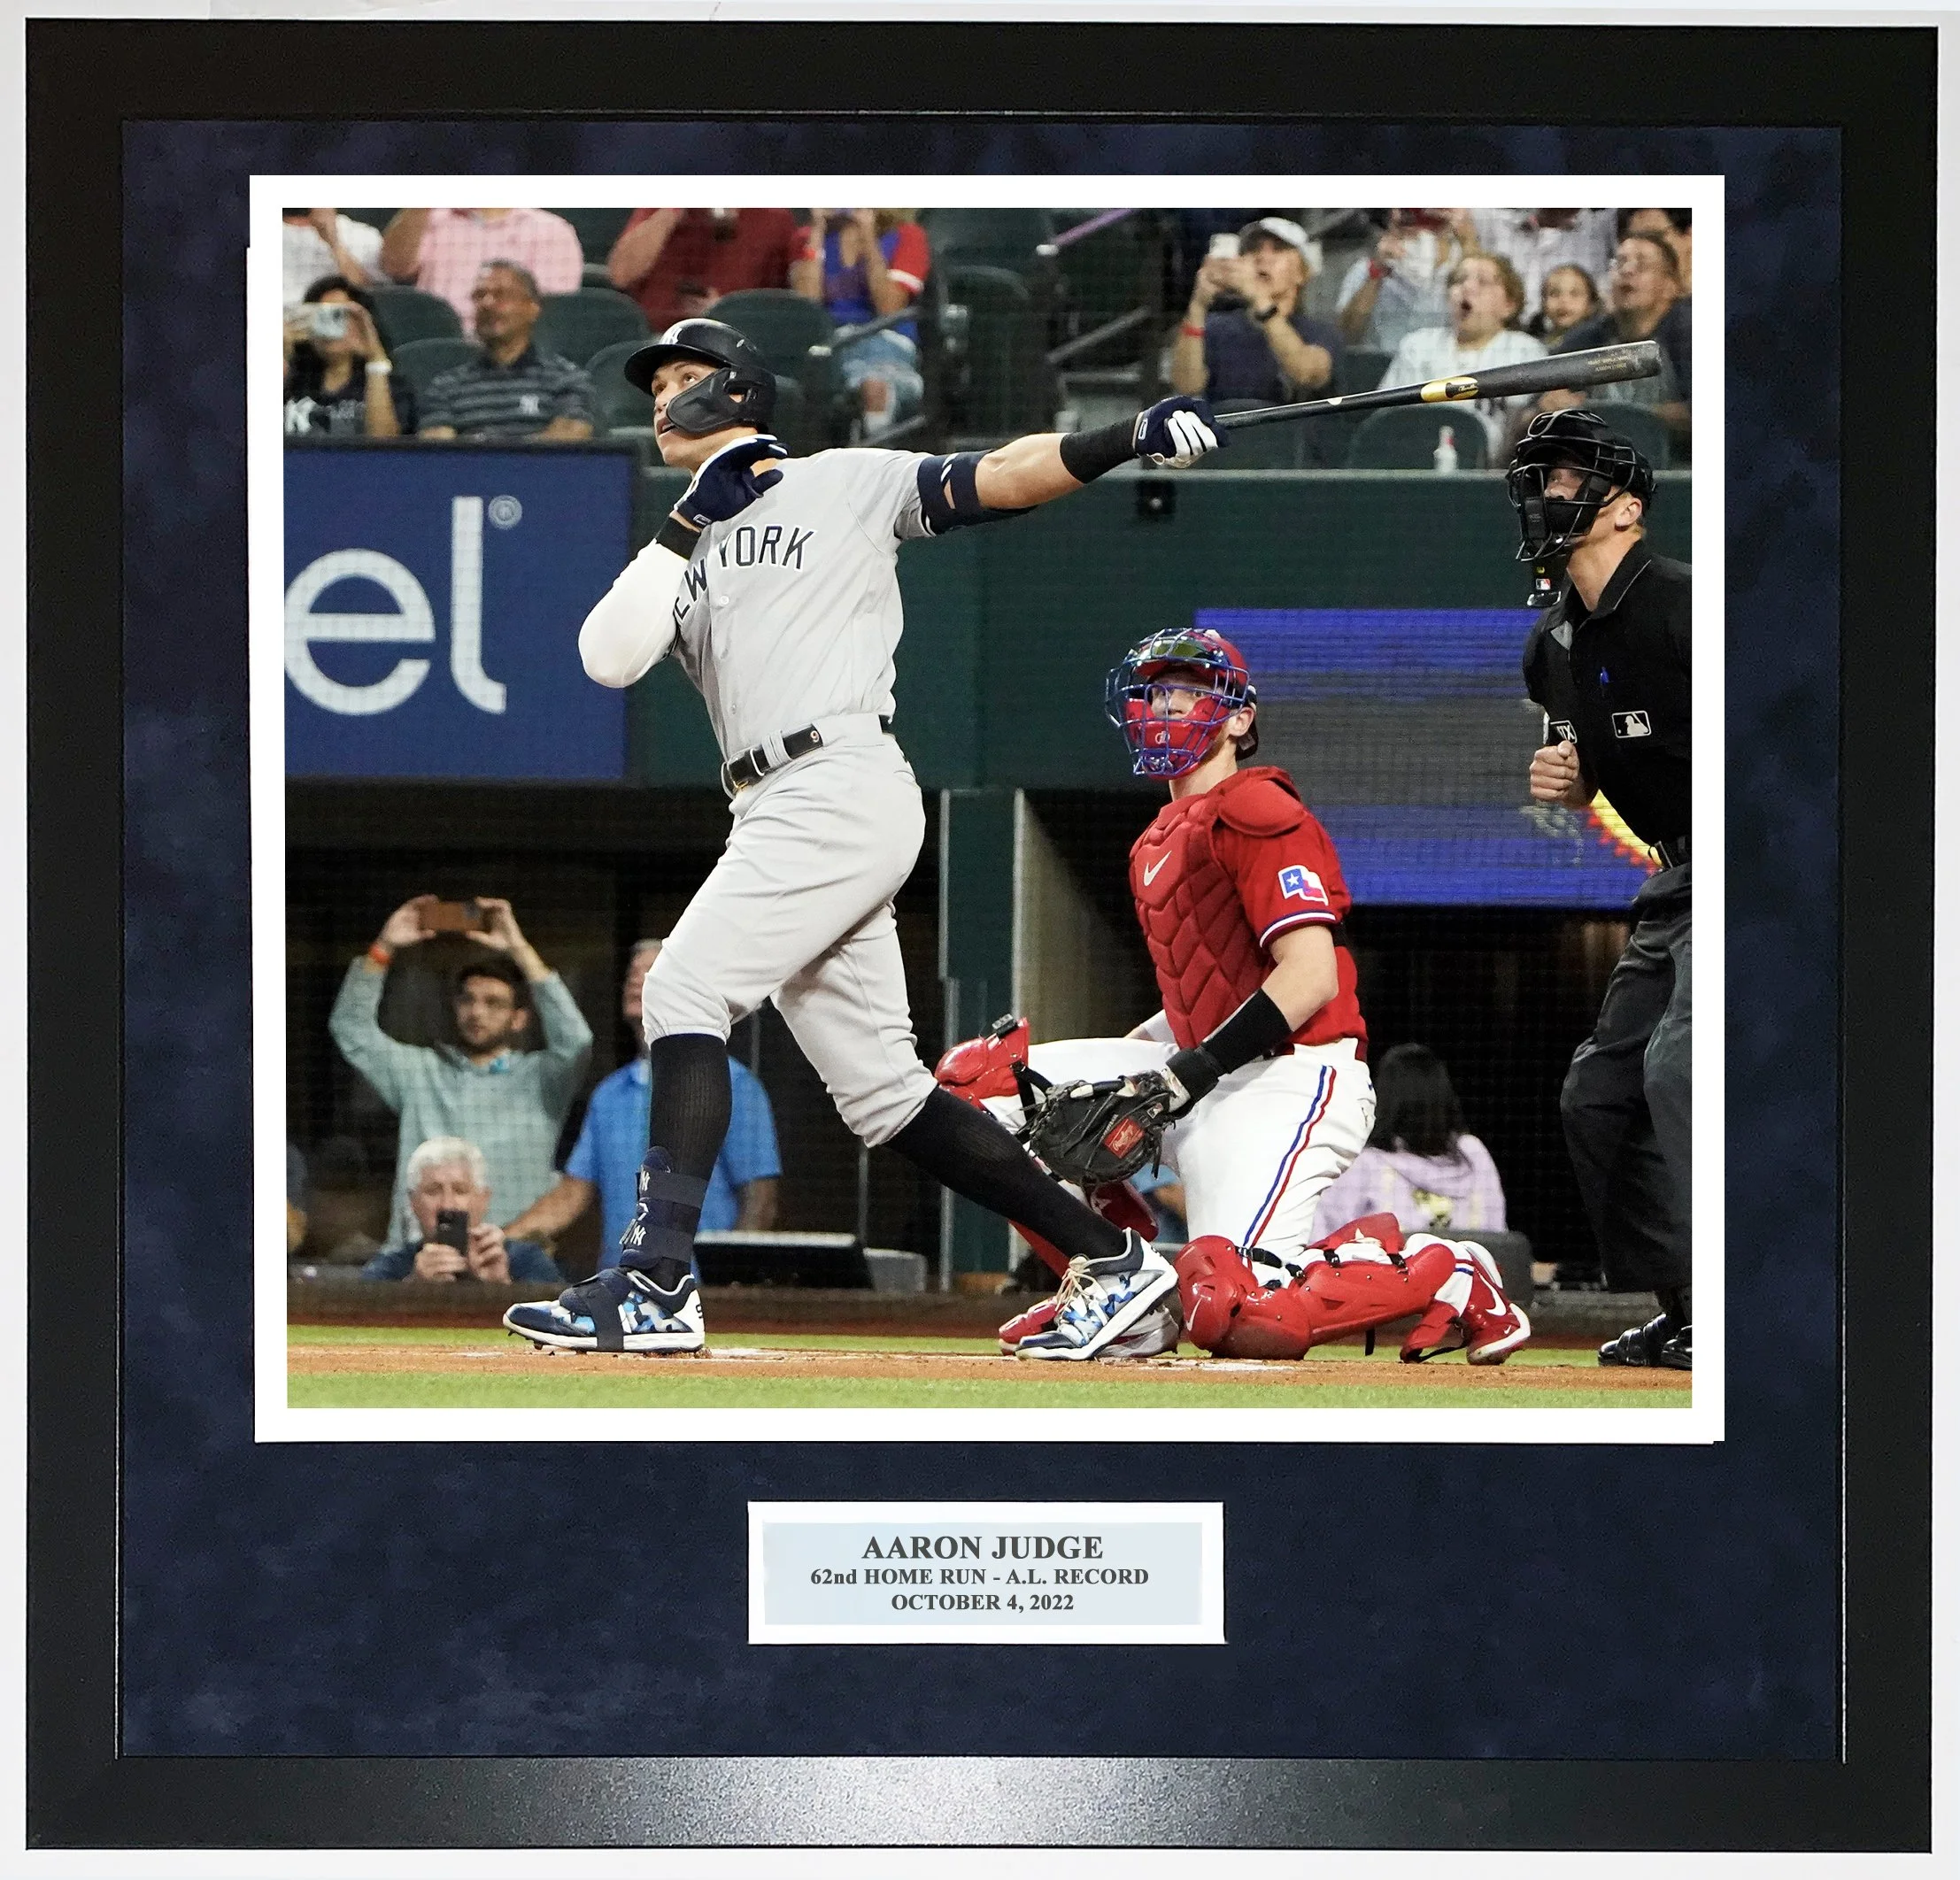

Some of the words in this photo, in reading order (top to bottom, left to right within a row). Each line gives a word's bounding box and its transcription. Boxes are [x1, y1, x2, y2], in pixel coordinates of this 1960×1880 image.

[673, 559, 708, 620] EW
[719, 525, 815, 570] YORK
[861, 1536, 983, 1560] AARON
[992, 1536, 1104, 1560] JUDGE
[810, 1568, 858, 1584] 62nd
[863, 1568, 933, 1584] HOME
[939, 1568, 987, 1584] RUN
[1005, 1568, 1047, 1584] A.L.
[1053, 1568, 1149, 1584] RECORD
[891, 1594, 1001, 1610] OCTOBER
[1007, 1594, 1024, 1614] 4,
[1030, 1594, 1074, 1610] 2022
